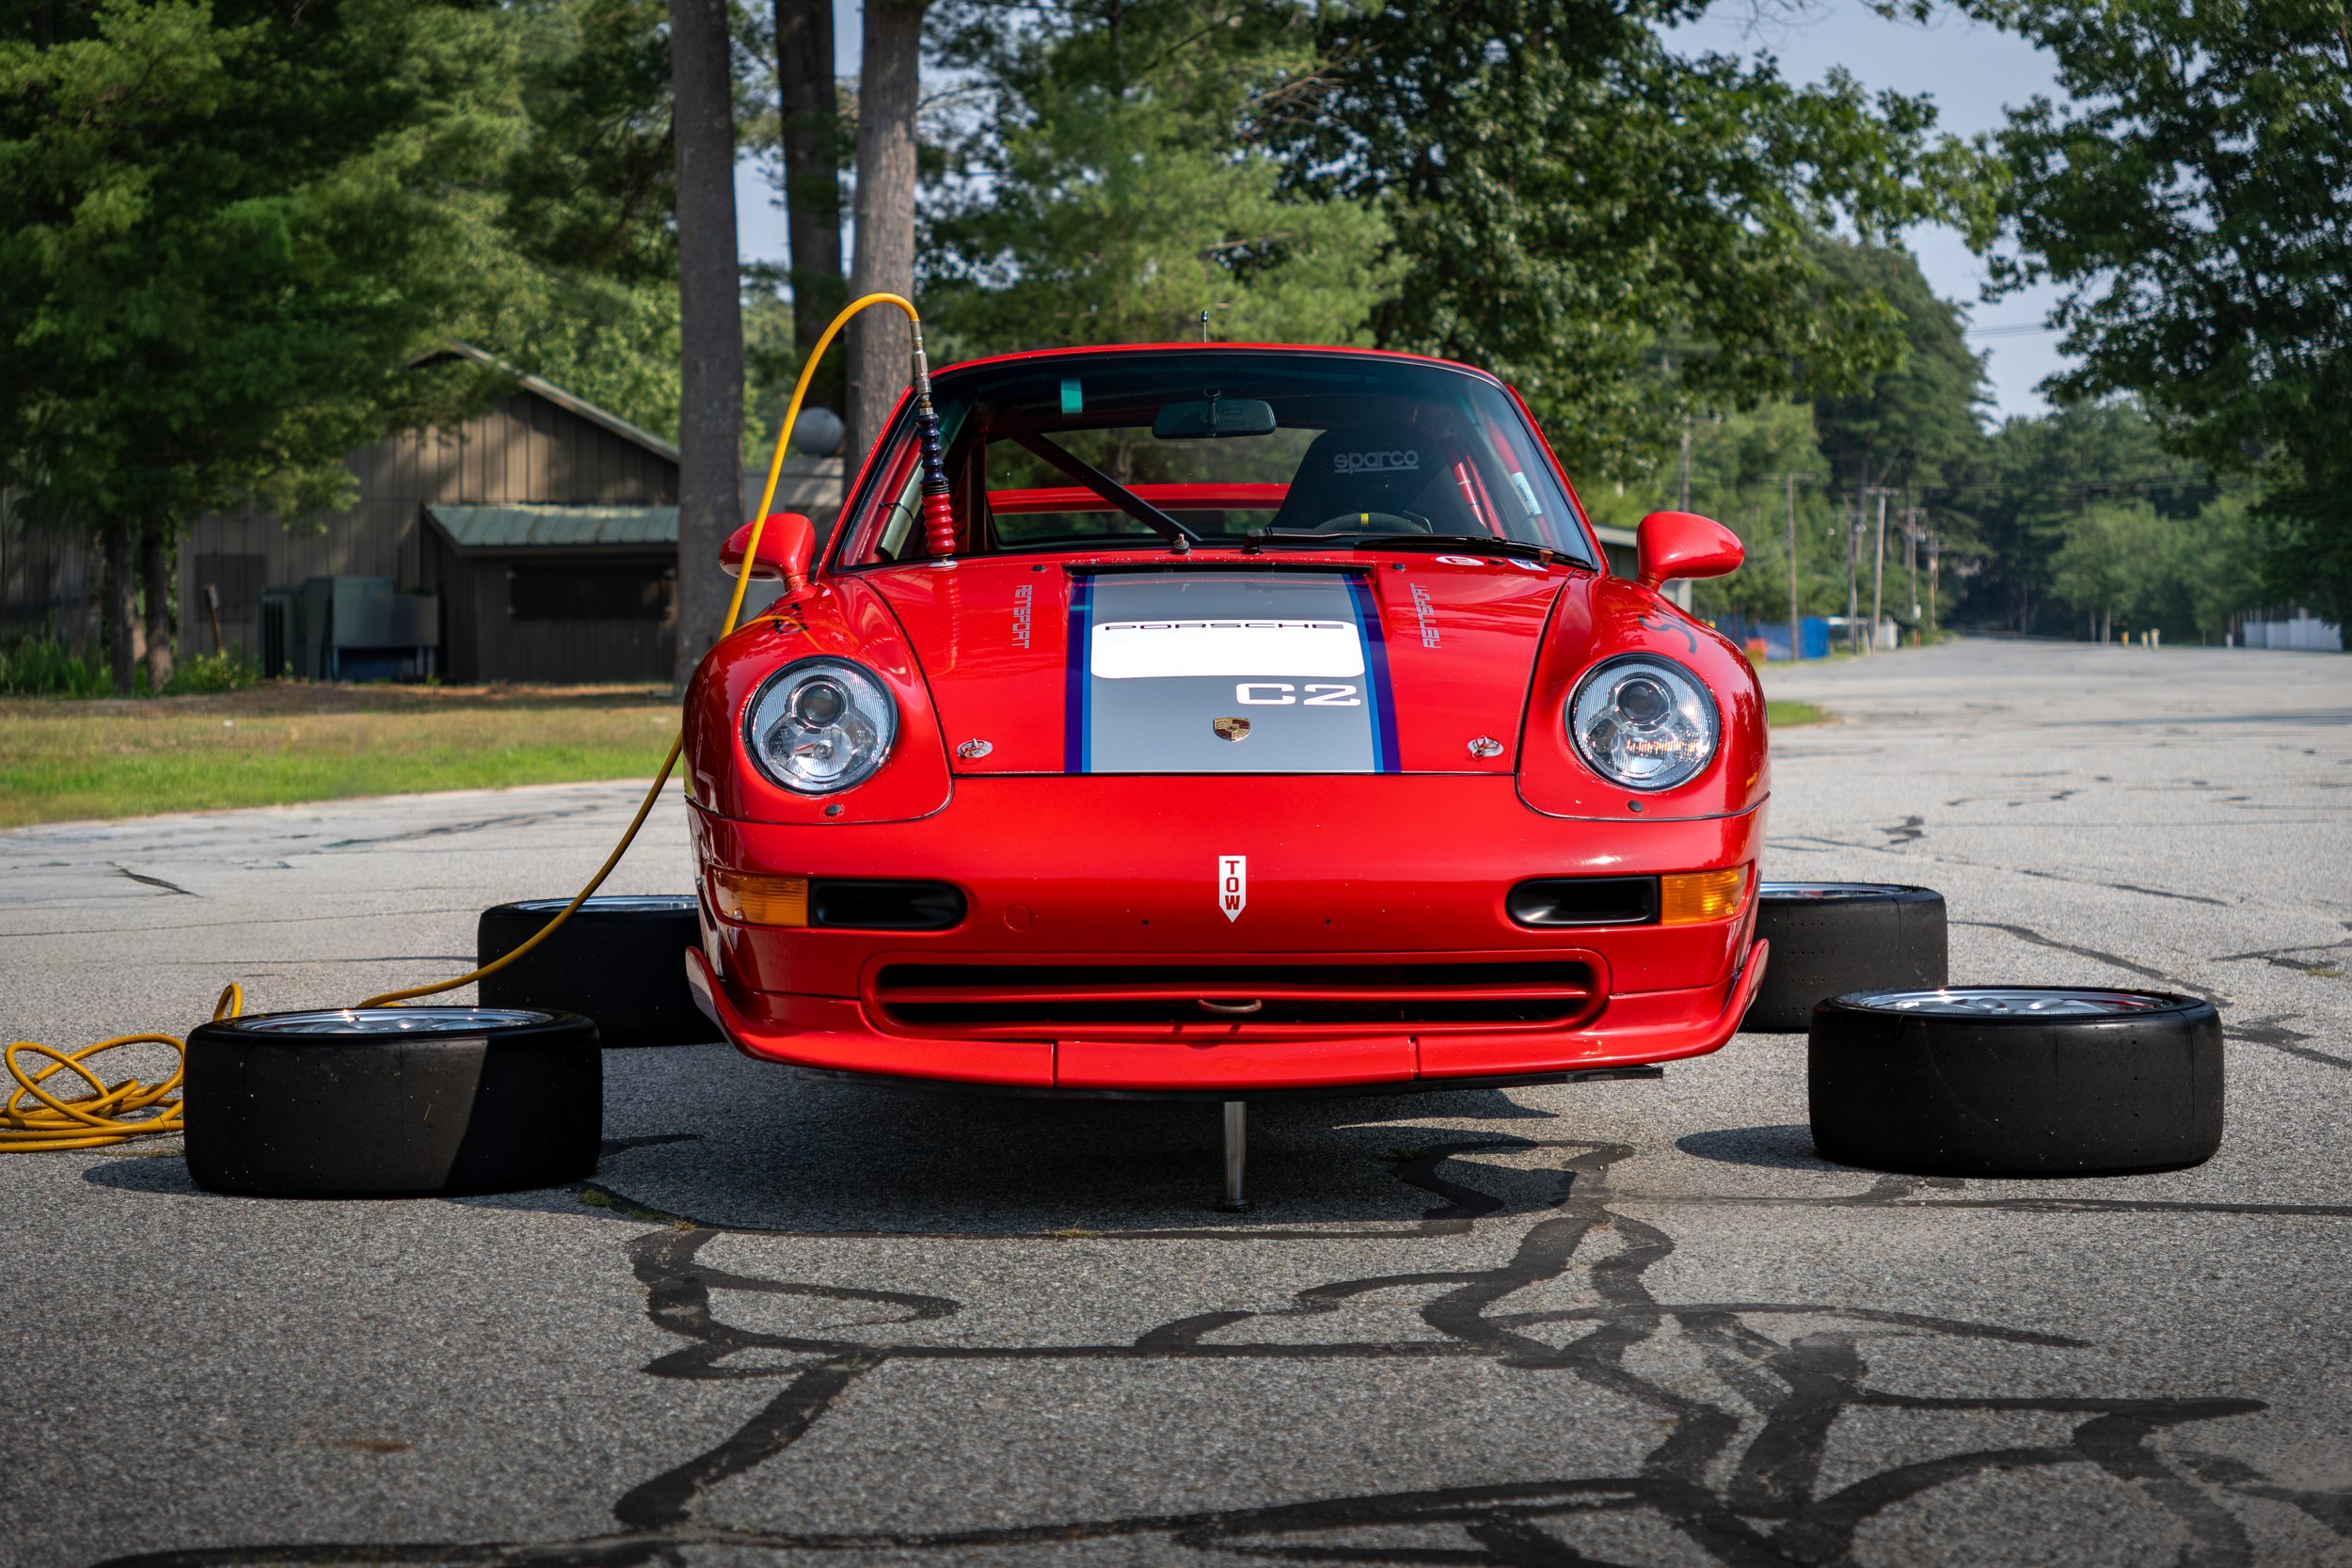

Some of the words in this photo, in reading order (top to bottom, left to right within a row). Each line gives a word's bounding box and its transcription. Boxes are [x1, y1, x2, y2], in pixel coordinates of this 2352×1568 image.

[1334, 450, 1419, 474] sparco
[1011, 584, 1032, 649] RENNSPORT
[1409, 582, 1441, 648] RENNSPORT
[1235, 683, 1361, 705] C2
[1225, 860, 1241, 911] TOW
